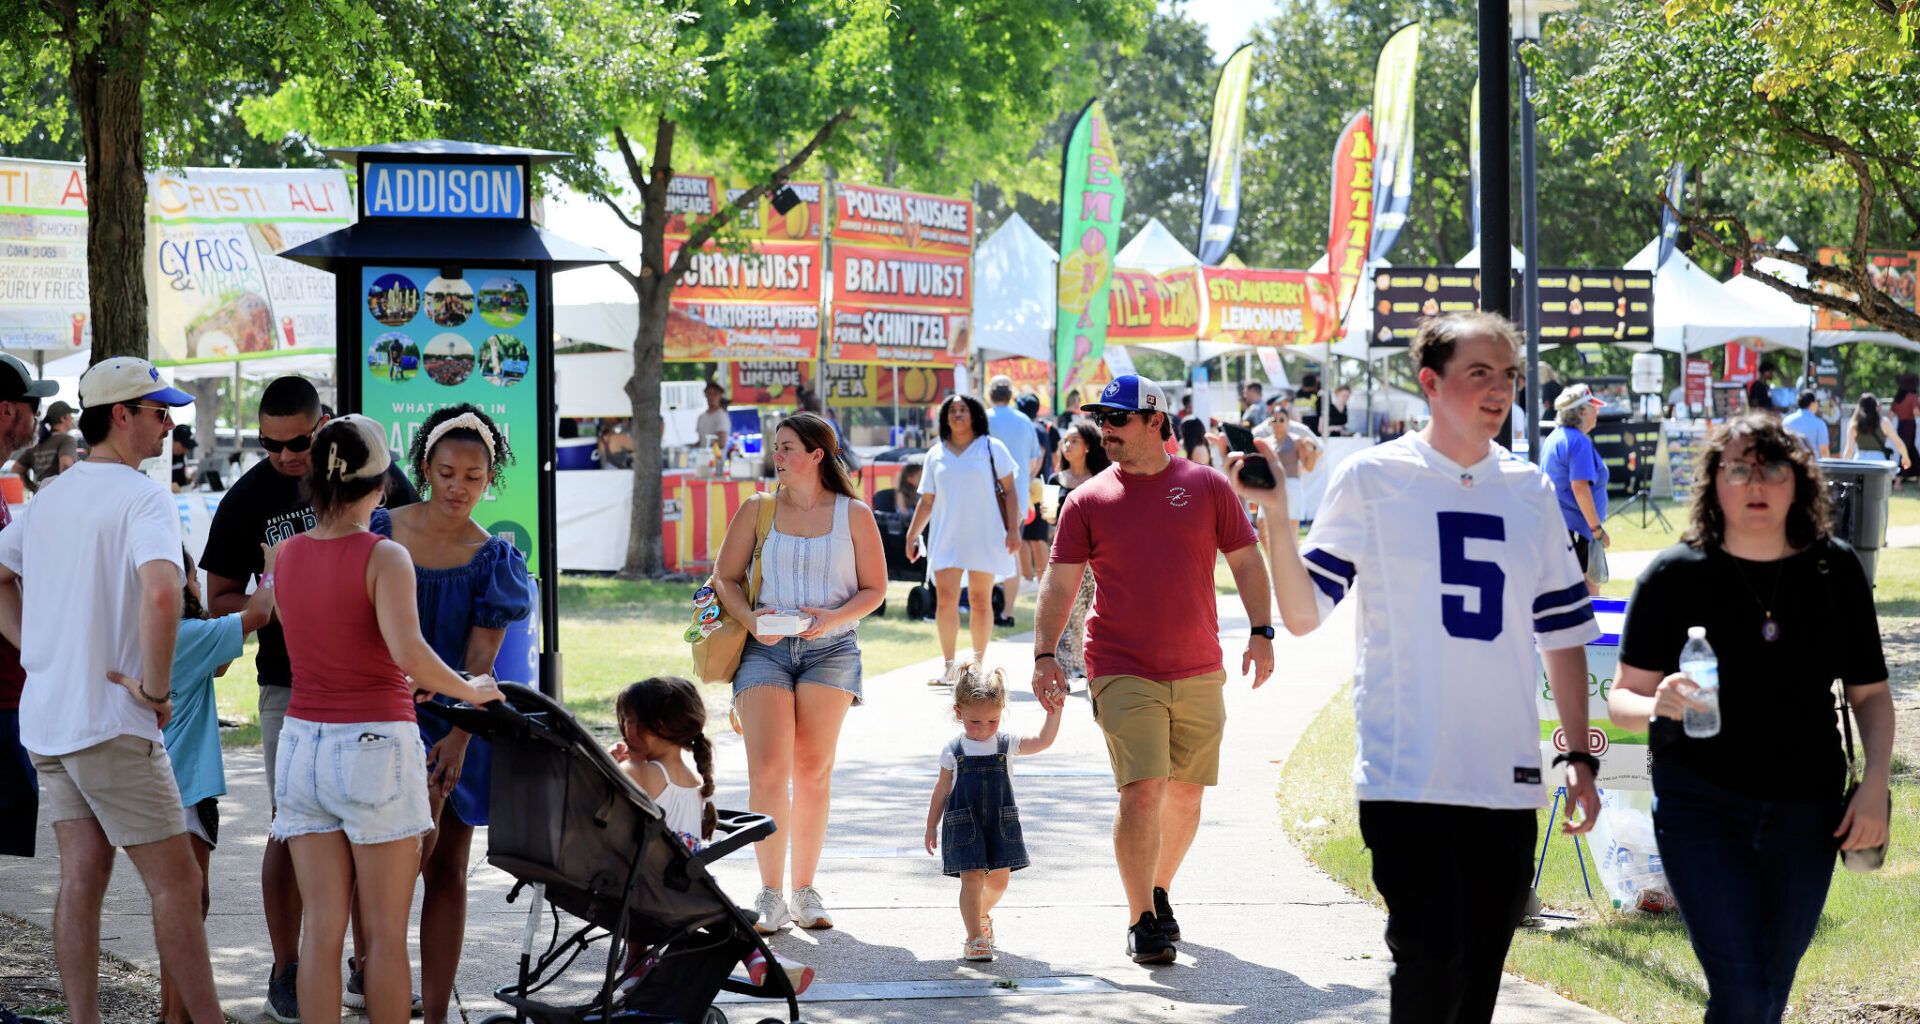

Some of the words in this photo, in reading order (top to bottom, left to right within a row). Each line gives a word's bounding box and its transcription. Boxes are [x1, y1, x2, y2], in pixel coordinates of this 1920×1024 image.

[159, 179, 267, 213] CRISTI
[373, 168, 512, 214] ADDISON
[667, 177, 708, 196] HERRY
[844, 190, 903, 222] POLISH
[905, 197, 967, 233] SAUSAGE
[45, 281, 86, 300] FRIES
[194, 265, 262, 296] WRAPS
[845, 257, 964, 297] BRATWURST
[1209, 277, 1305, 305] STRAWBERRY
[862, 311, 947, 348] SCHNITZEL
[1221, 306, 1303, 332] LEMONADE
[739, 371, 800, 387] LIMEADE
[824, 380, 867, 397] TEA
[392, 403, 434, 413] WHAT
[491, 403, 506, 414] IN
[1437, 511, 1506, 642] 5
